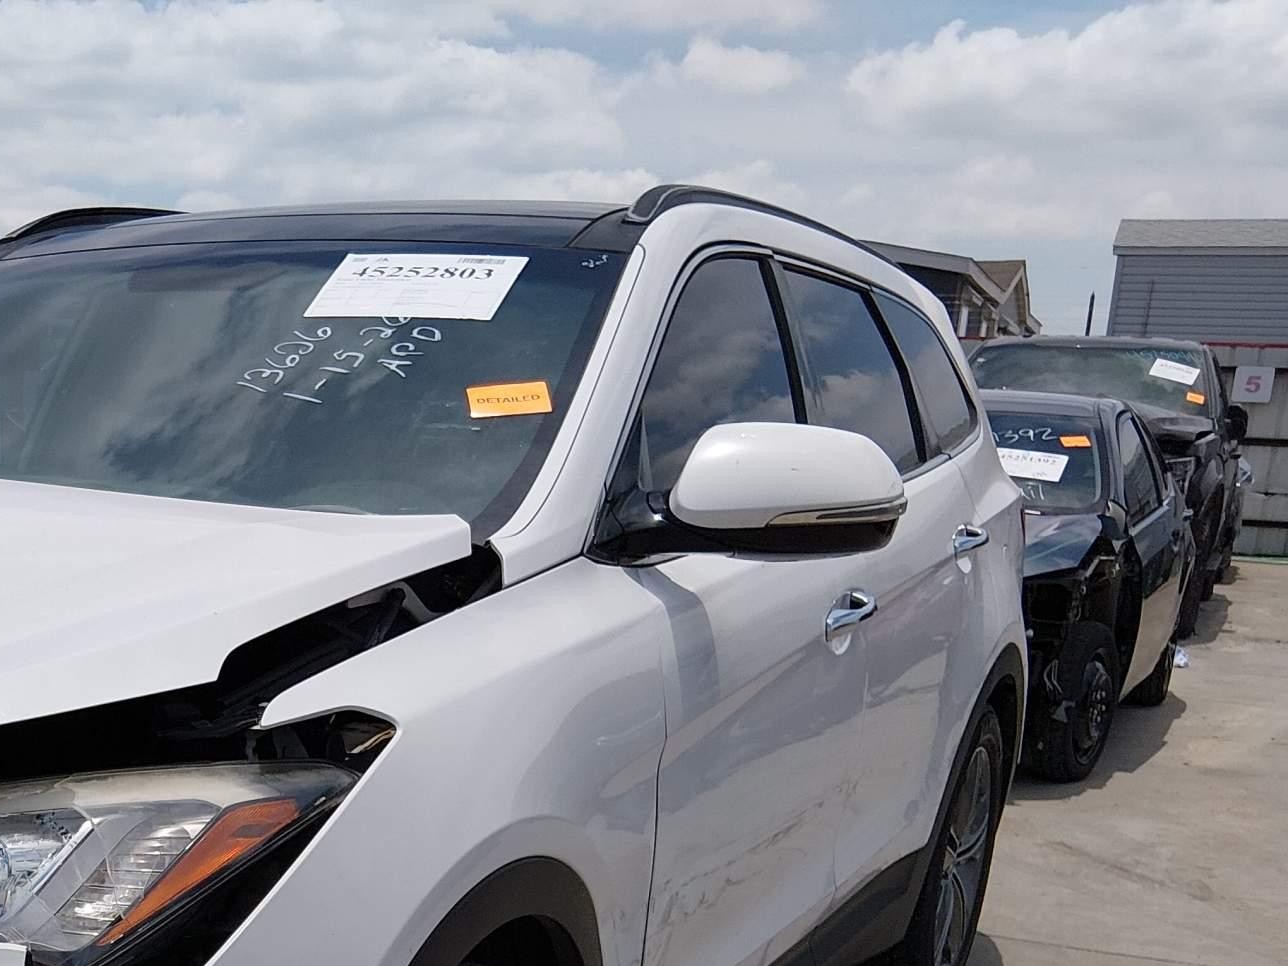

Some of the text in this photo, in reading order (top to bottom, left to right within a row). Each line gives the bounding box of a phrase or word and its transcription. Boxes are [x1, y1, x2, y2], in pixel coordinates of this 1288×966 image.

[352, 265, 494, 281] 45252803
[236, 326, 331, 393] 13626
[377, 326, 442, 378] APD
[1244, 375, 1263, 394] 5
[476, 394, 541, 405] DETAILED
